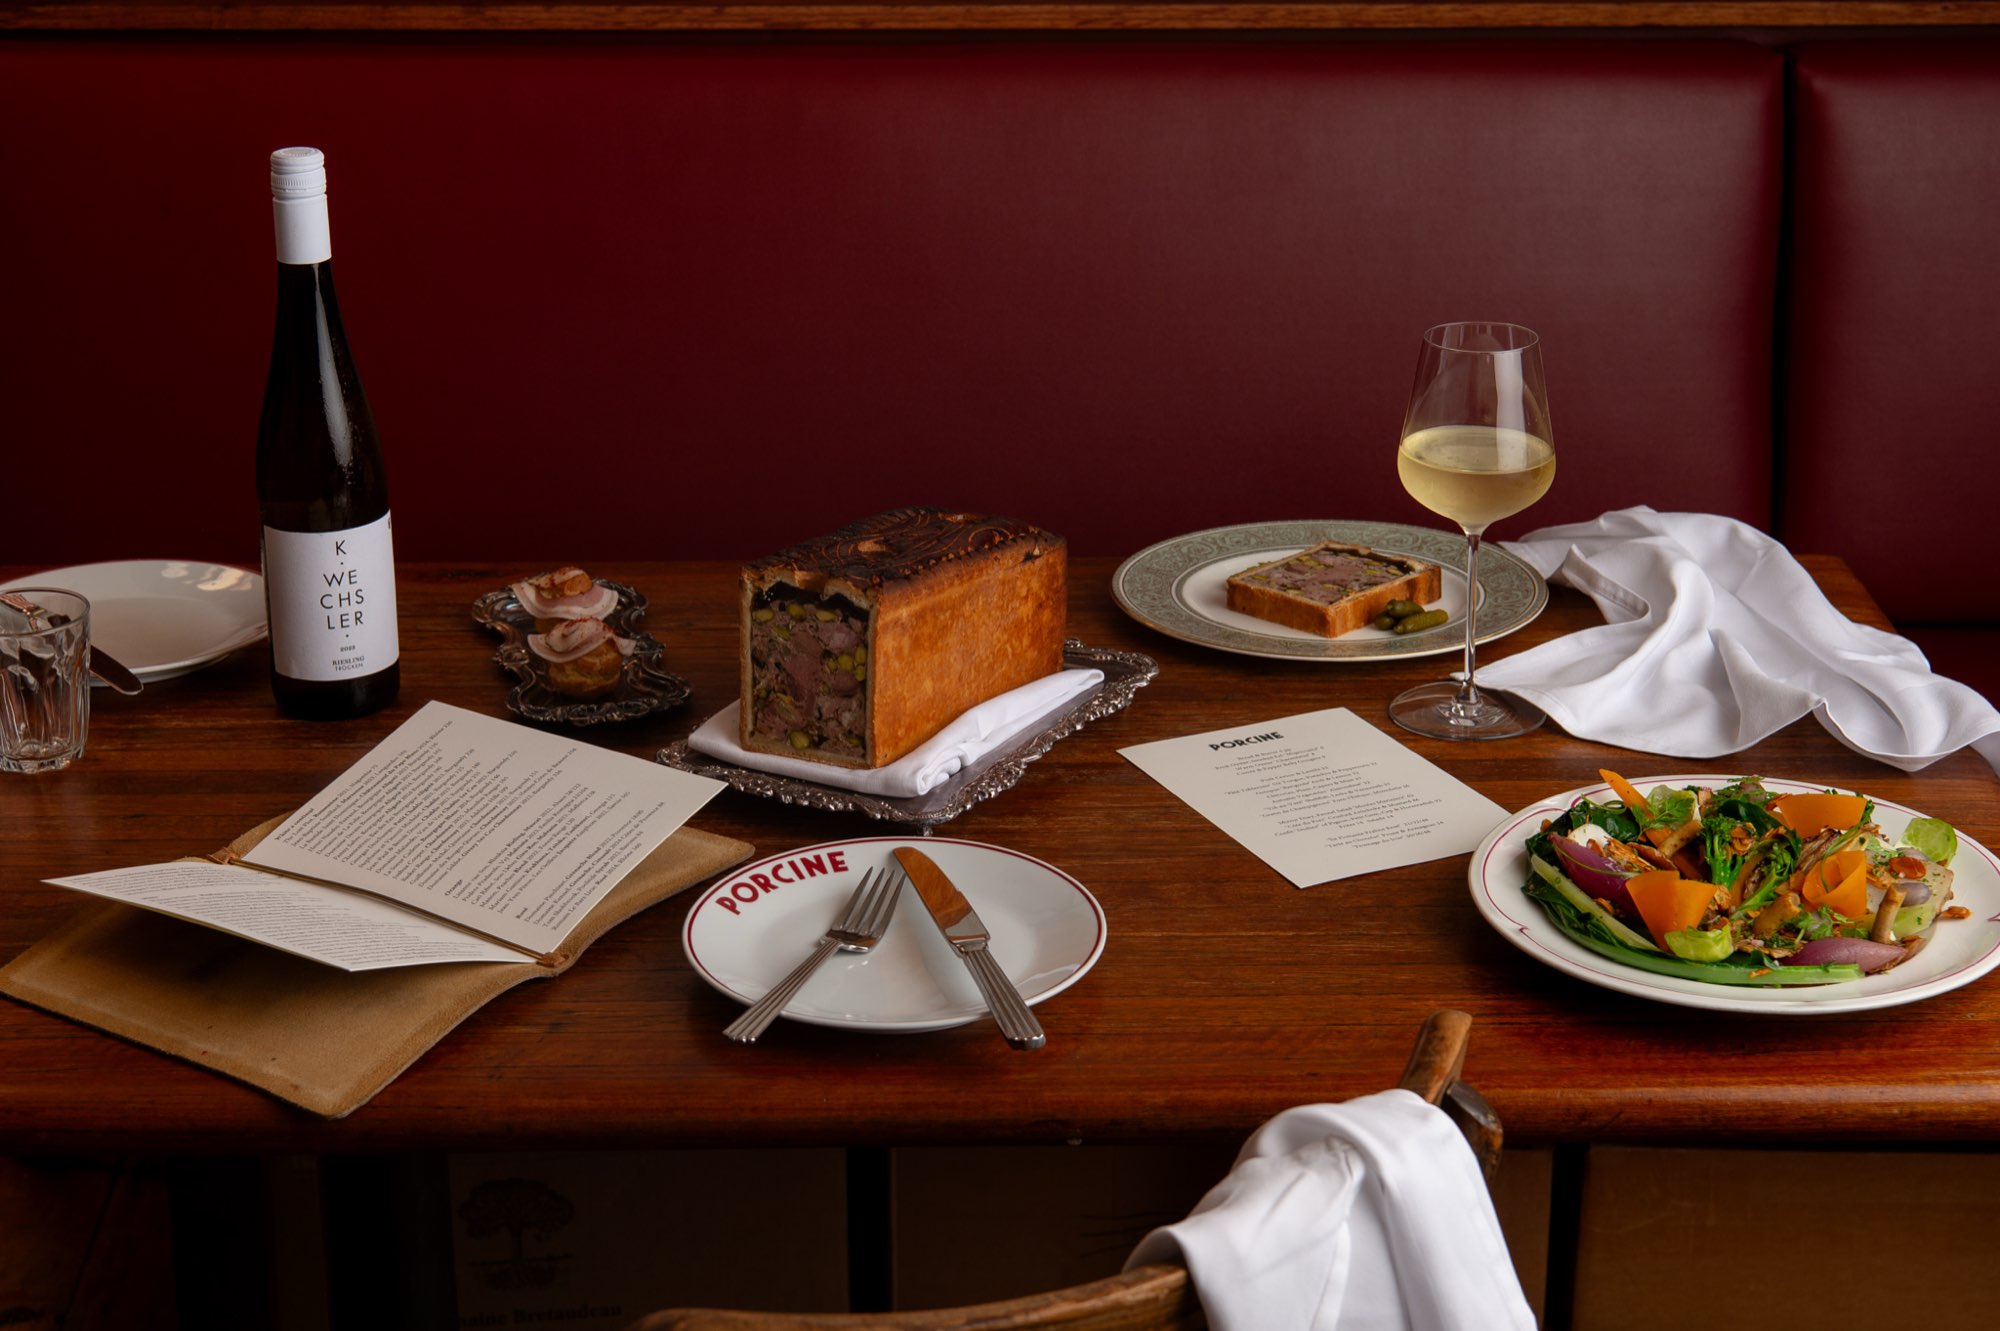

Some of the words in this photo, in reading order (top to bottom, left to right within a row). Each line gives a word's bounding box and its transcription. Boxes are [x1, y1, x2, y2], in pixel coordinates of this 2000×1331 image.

[335, 540, 346, 555] K
[323, 569, 358, 587] WE
[320, 589, 365, 609] CHS
[327, 611, 364, 630] LER
[332, 655, 365, 666] RIESLING
[334, 663, 364, 672] TROCKEN
[1209, 731, 1284, 751] PORCINE
[715, 851, 849, 916] PORCINE
